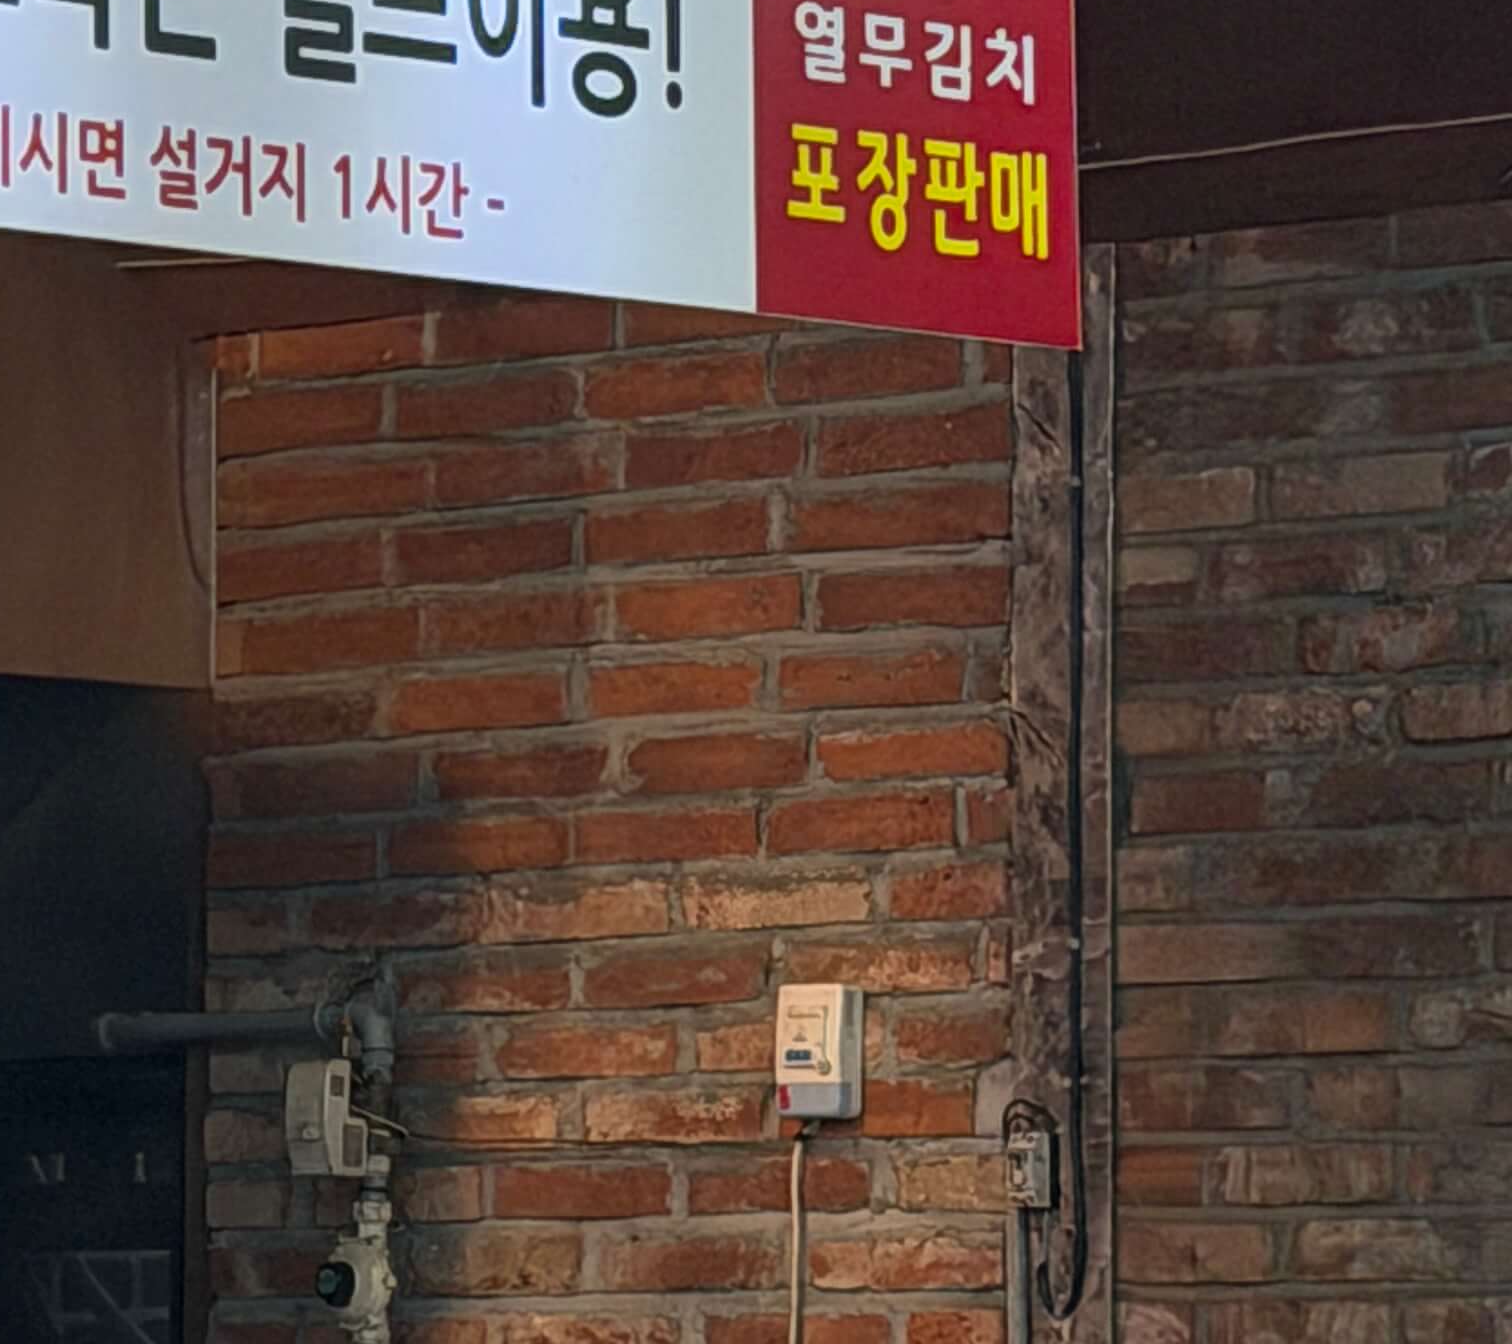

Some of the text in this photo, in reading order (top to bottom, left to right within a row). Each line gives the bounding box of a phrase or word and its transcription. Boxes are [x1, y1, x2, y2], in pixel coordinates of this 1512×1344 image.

[795, 1, 1035, 105] 열무김치
[150, 127, 306, 224] 설거지
[333, 154, 468, 240] 1시간
[788, 124, 1048, 259] 포장판매
